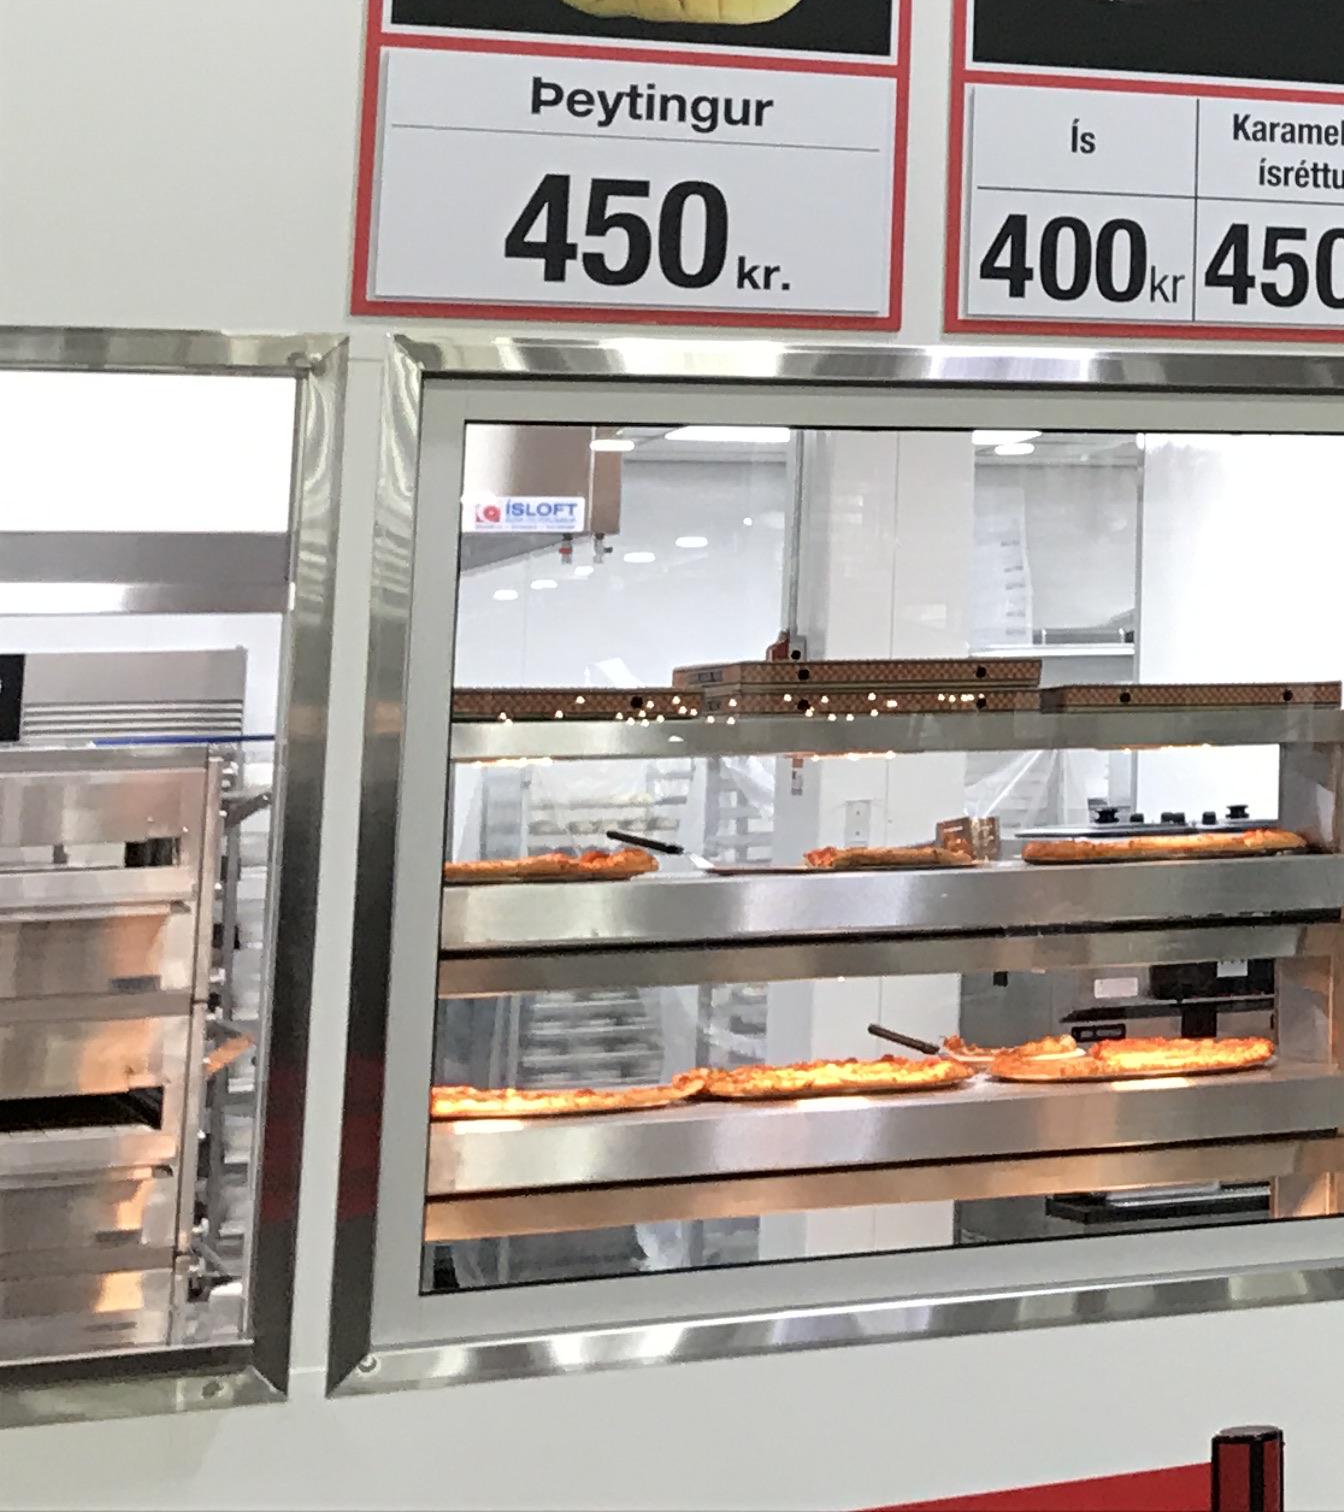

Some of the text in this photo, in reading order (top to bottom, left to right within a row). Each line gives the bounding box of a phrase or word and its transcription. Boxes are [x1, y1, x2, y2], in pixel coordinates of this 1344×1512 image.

[531, 76, 774, 133] Þeytingur
[1070, 119, 1096, 154] Ís
[504, 173, 791, 291] 450 kr.
[979, 213, 1185, 303] 400 kr
[505, 499, 578, 517] ÍSLOFT
